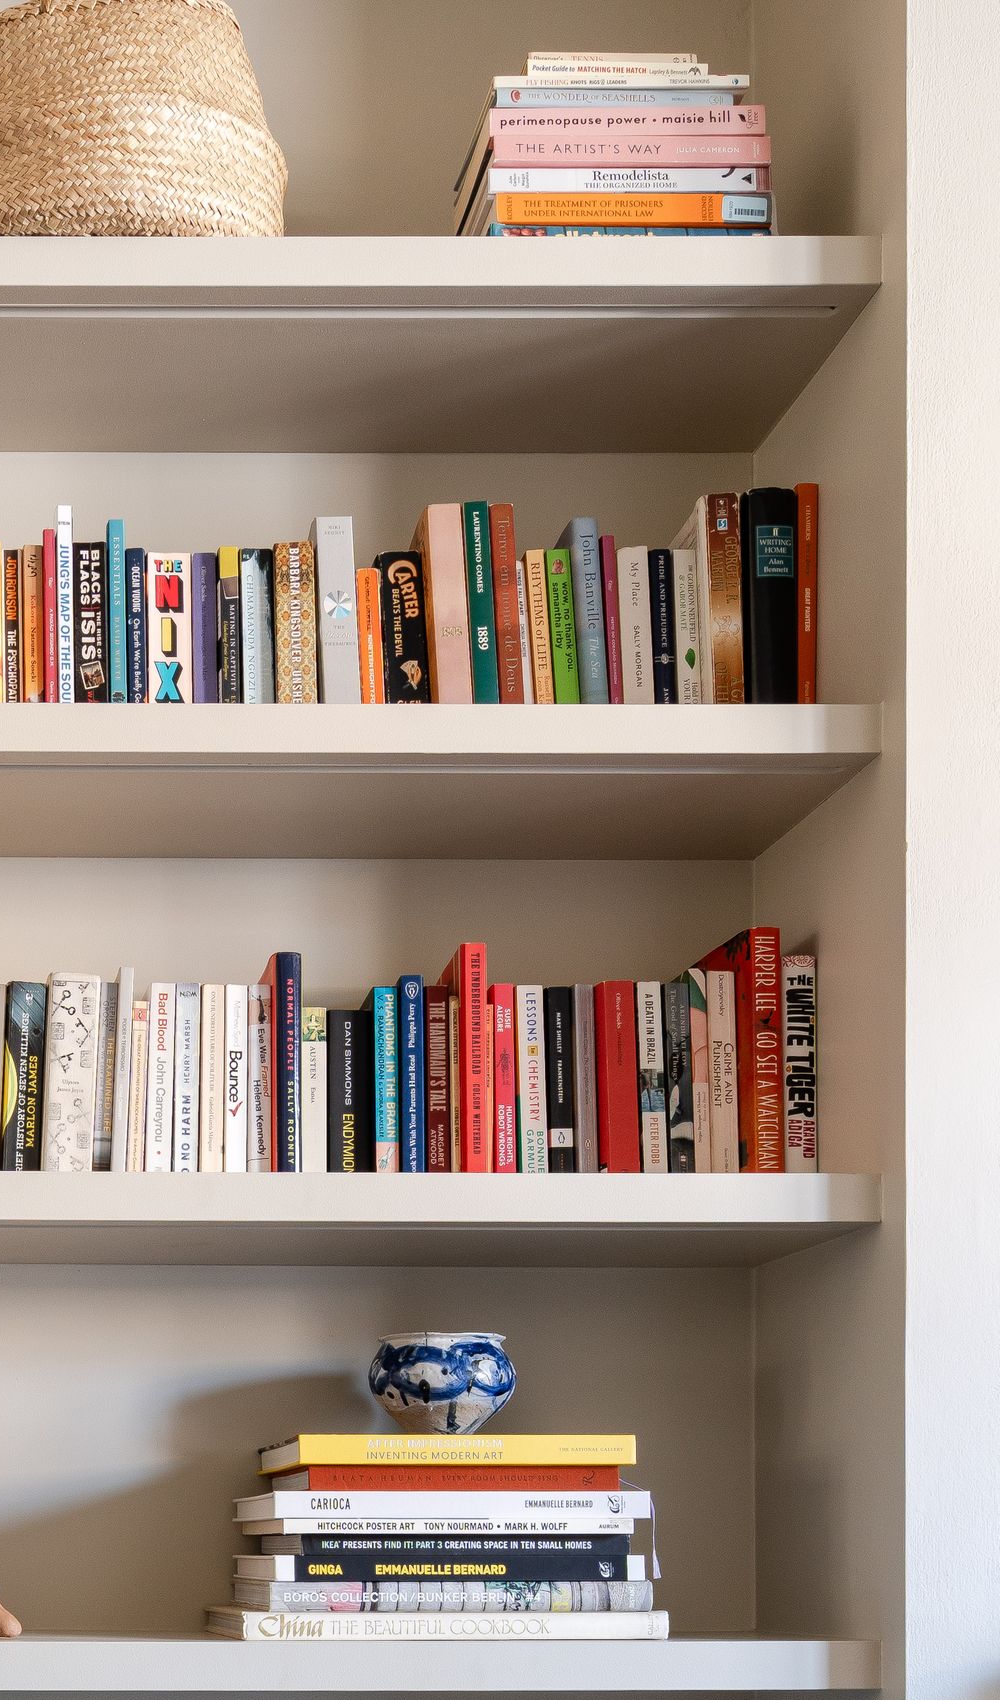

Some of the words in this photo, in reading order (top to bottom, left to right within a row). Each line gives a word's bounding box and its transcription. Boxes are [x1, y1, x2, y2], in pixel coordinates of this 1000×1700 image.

[500, 116, 601, 129] perimenopause
[608, 117, 646, 127] power
[662, 113, 704, 123] maisie
[710, 111, 730, 122] hill
[516, 144, 545, 153] THE
[553, 144, 620, 154] ARTIST'S
[628, 145, 661, 154] WAY
[592, 170, 669, 180] Remodelista
[473, 511, 482, 562] LAURENTINO
[760, 538, 792, 547] WRITING
[580, 534, 594, 566] John
[764, 546, 788, 554] HOME
[768, 557, 785, 566] Alan
[80, 550, 90, 605] FLAGS
[91, 550, 101, 604] BLACK
[154, 560, 183, 573] THE
[475, 565, 483, 593] GOMES
[629, 562, 639, 577] My
[711, 551, 723, 592] MARTIN
[763, 565, 789, 574] Bennett
[388, 559, 419, 618] CARTER
[392, 588, 400, 613] BEATS
[530, 562, 542, 627] RHYTHMS
[585, 572, 599, 629] Banville
[631, 582, 640, 607] Place
[246, 575, 255, 650] CHIMAMANDA
[552, 582, 561, 628] samantha
[80, 611, 96, 660] ISIS
[393, 615, 401, 632] THE
[536, 629, 544, 641] of
[633, 625, 641, 648] SALLY
[660, 603, 668, 648] PREJUDICE
[230, 638, 236, 646] IN
[394, 634, 402, 657] DEVIL
[478, 626, 488, 650] 1889
[555, 631, 563, 649] irby
[589, 637, 599, 656] The
[538, 644, 547, 671] LIFE
[591, 660, 600, 679] Sea
[635, 651, 643, 687] MORGAN
[247, 655, 256, 690] NGOZI
[755, 936, 776, 986] HARPER
[787, 974, 813, 986] THE
[158, 993, 168, 1015] Bad
[429, 1001, 446, 1020] THE
[755, 993, 776, 1011] LEE
[385, 994, 395, 1057] PHANTOMS
[496, 1005, 504, 1032] ALEGRE
[157, 1018, 168, 1051] Blood
[756, 1032, 777, 1048] GO
[386, 1061, 395, 1073] IN
[429, 1022, 446, 1088] HANDMAID'S
[756, 1054, 777, 1075] SET
[27, 1055, 38, 1094] JAMES
[153, 1057, 166, 1085] John
[229, 1050, 241, 1102] Bounce
[713, 1040, 722, 1108] PUNISHMENT
[253, 1080, 263, 1111] Helena
[287, 1080, 295, 1113] SALLY
[386, 1077, 395, 1097] THE
[757, 1080, 777, 1089] A
[430, 1089, 446, 1111] TALE
[26, 1096, 36, 1147] MARLON
[153, 1087, 166, 1143] Carreyrou
[386, 1102, 396, 1138] BRAIN
[255, 1115, 266, 1155] Kennedy
[287, 1119, 295, 1164] ROONEY
[756, 1094, 779, 1169] WATCHMAN
[788, 1119, 802, 1148] ADIGA
[803, 1120, 815, 1158] ARAVIND
[430, 1129, 438, 1164] ATWOOD
[366, 1451, 429, 1460] INVENTING
[432, 1451, 480, 1460] MODERN
[484, 1451, 503, 1460] ART
[367, 1439, 404, 1449] AFTER
[407, 1439, 504, 1449] IMPRESSIONISM
[311, 1498, 351, 1510] CARIOCA
[525, 1500, 564, 1508] EMMANUELLE
[566, 1500, 593, 1508] BERNARD
[318, 1522, 364, 1530] HITCHCOCK
[366, 1522, 397, 1530] POSTER
[399, 1522, 415, 1530] ART
[424, 1522, 446, 1530] TONY
[447, 1522, 494, 1530] NOURMAND
[308, 1564, 343, 1575] GINGA
[375, 1564, 451, 1575] EMMANUELLE
[453, 1564, 507, 1575] BERNARD
[258, 1614, 324, 1640] China
[330, 1620, 359, 1636] THE
[364, 1620, 446, 1636] BEAUTIFUL
[450, 1619, 551, 1635] COOKBOOK
